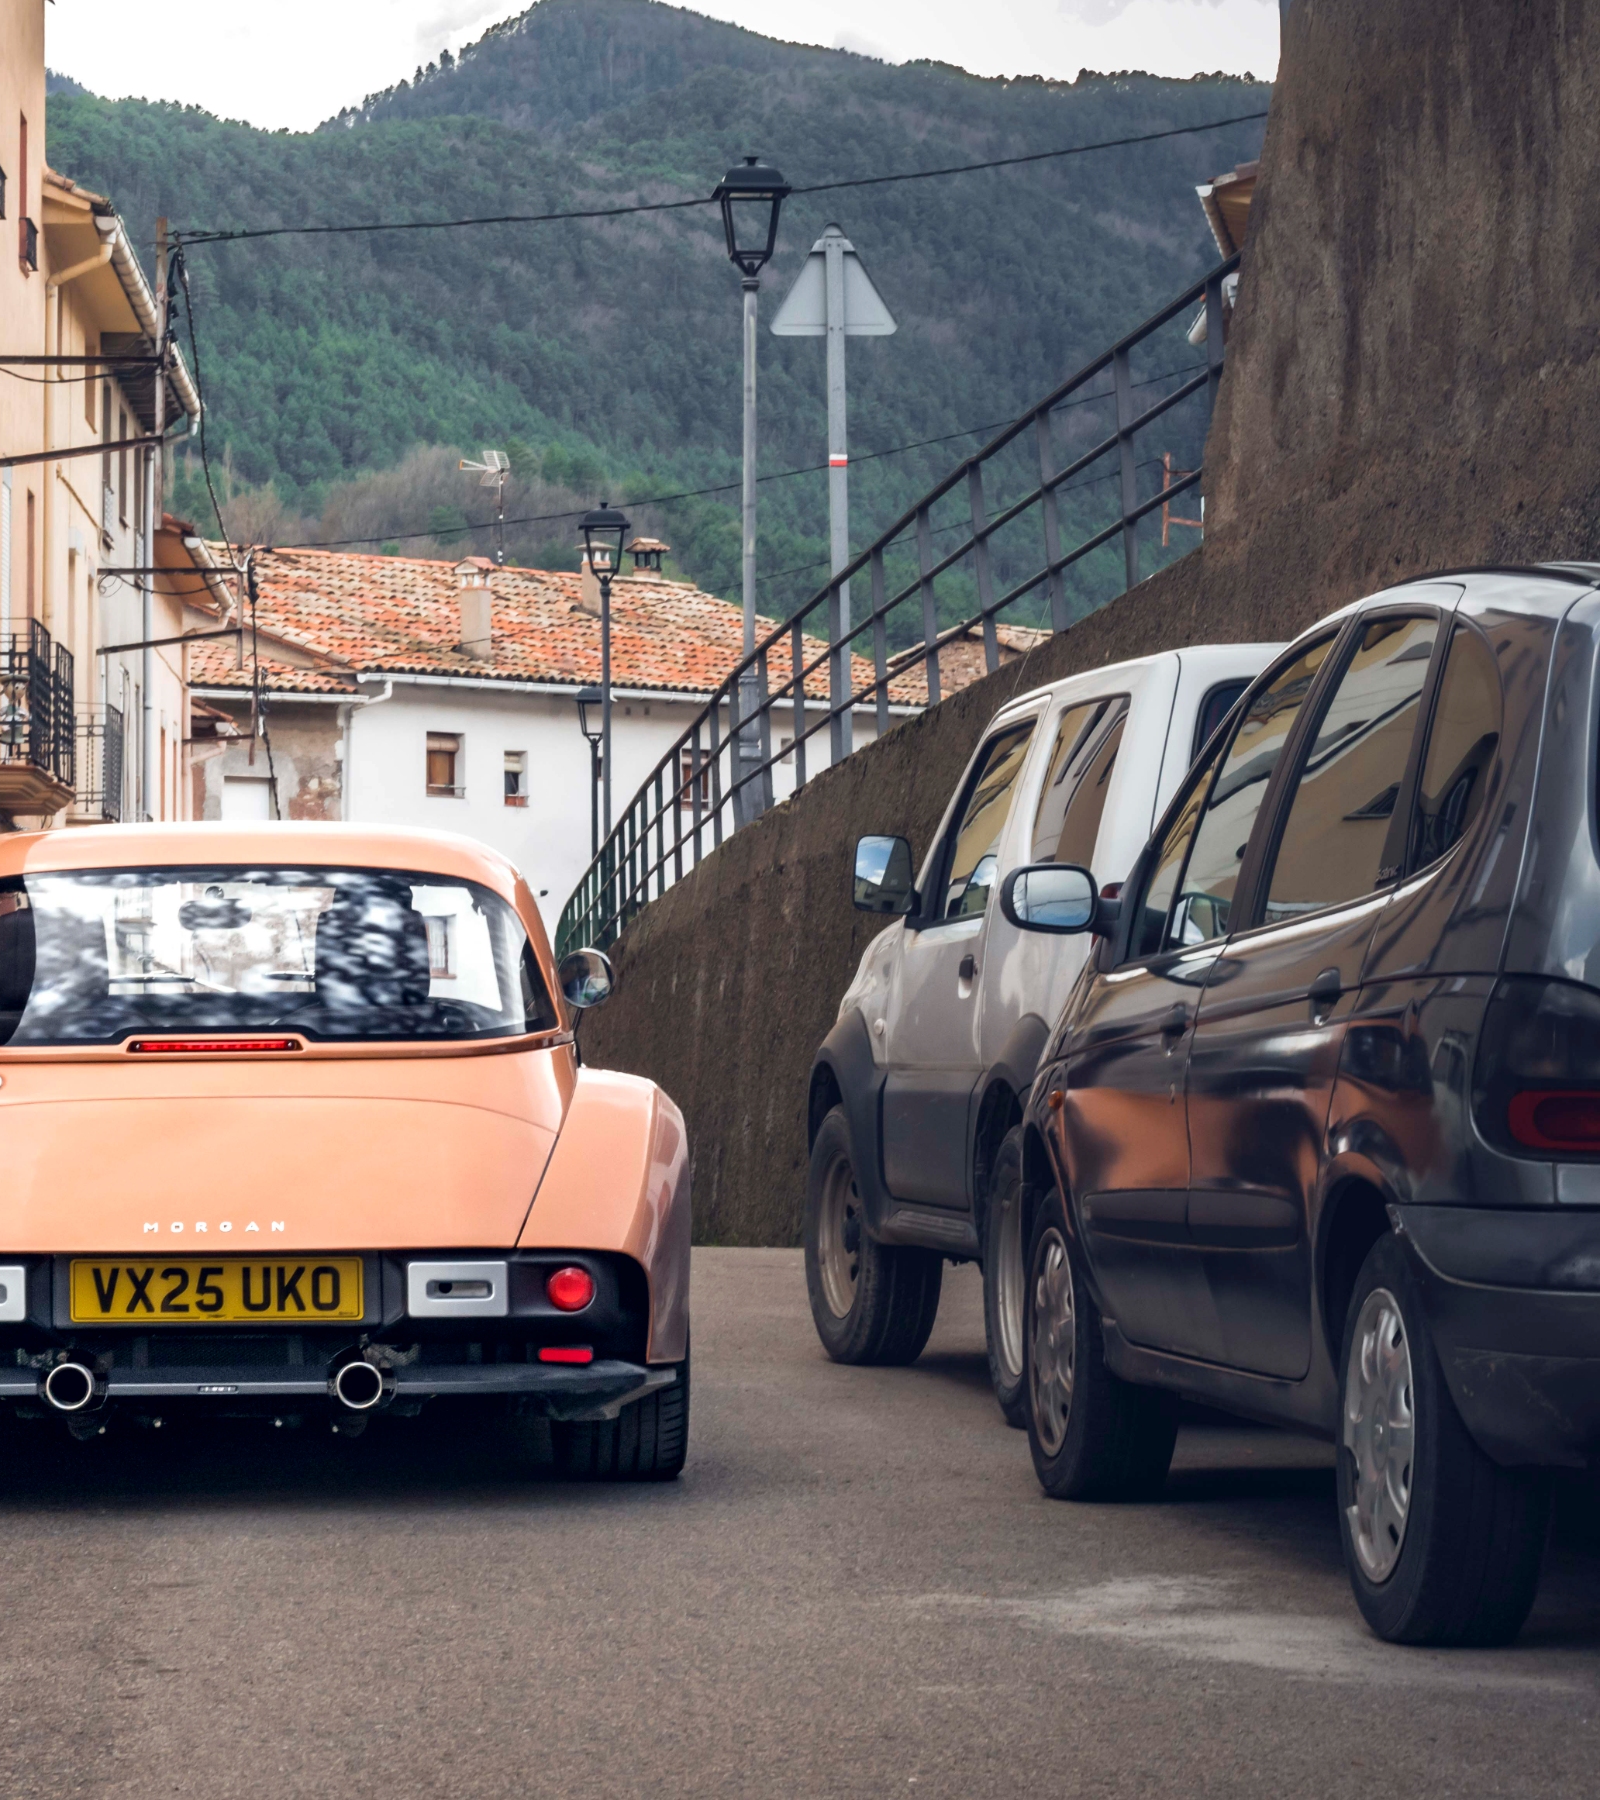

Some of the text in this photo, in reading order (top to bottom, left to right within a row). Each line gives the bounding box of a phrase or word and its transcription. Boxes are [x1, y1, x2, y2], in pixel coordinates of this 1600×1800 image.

[143, 1221, 285, 1234] MORGAN
[92, 1265, 341, 1313] VX25 UKO
